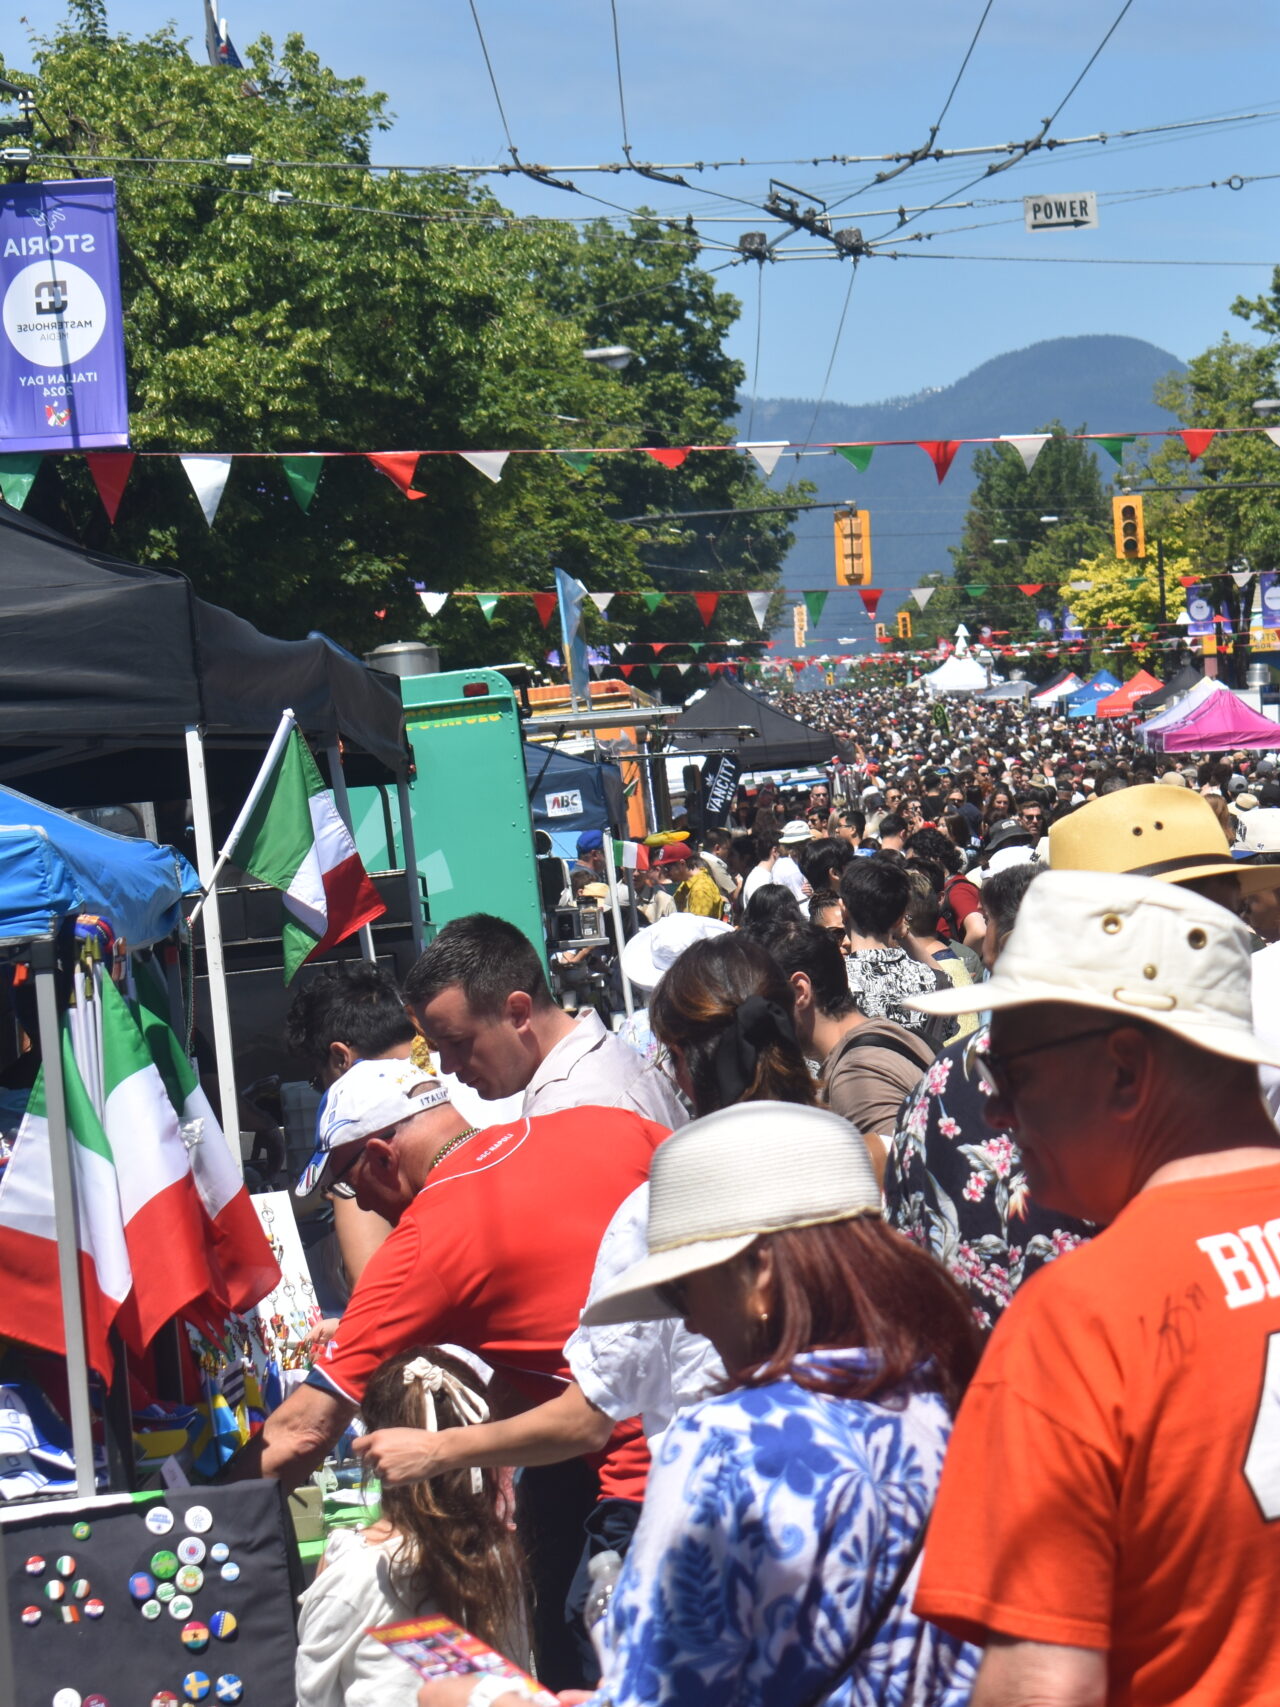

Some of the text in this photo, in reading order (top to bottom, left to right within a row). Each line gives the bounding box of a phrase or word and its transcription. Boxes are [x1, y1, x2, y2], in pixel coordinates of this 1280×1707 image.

[1032, 200, 1089, 220] POWER
[706, 757, 736, 812] VANCITY
[551, 794, 578, 809] ABC
[490, 1133, 514, 1152] NAPOLI
